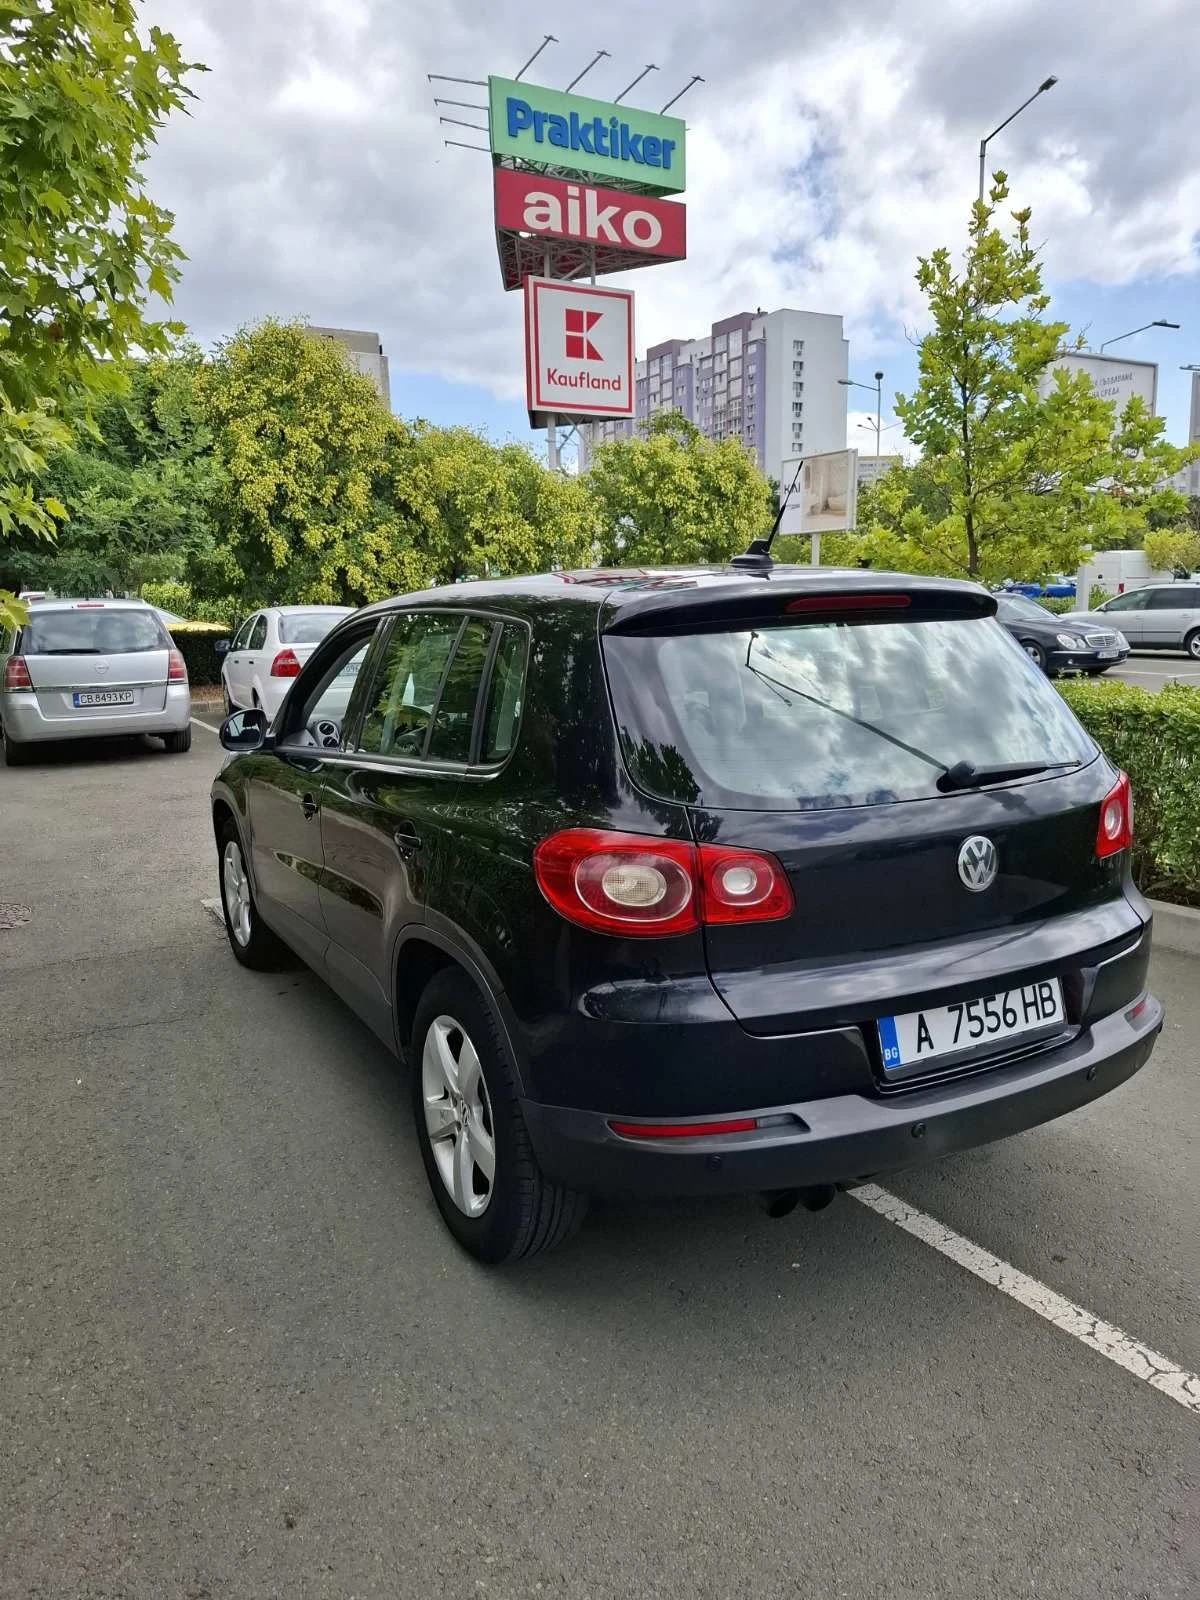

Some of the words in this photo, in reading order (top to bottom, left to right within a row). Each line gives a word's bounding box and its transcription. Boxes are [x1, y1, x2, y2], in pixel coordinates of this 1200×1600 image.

[506, 97, 675, 169] Praktiker
[522, 186, 662, 248] aiko
[565, 308, 604, 361] K
[547, 368, 621, 391] Kaufland
[81, 694, 93, 703] CB
[95, 693, 117, 702] 8493
[119, 691, 131, 701] KP
[884, 1047, 898, 1060] BG
[916, 1013, 934, 1053] A
[947, 991, 1018, 1044] 7556
[1020, 982, 1056, 1025] HB
